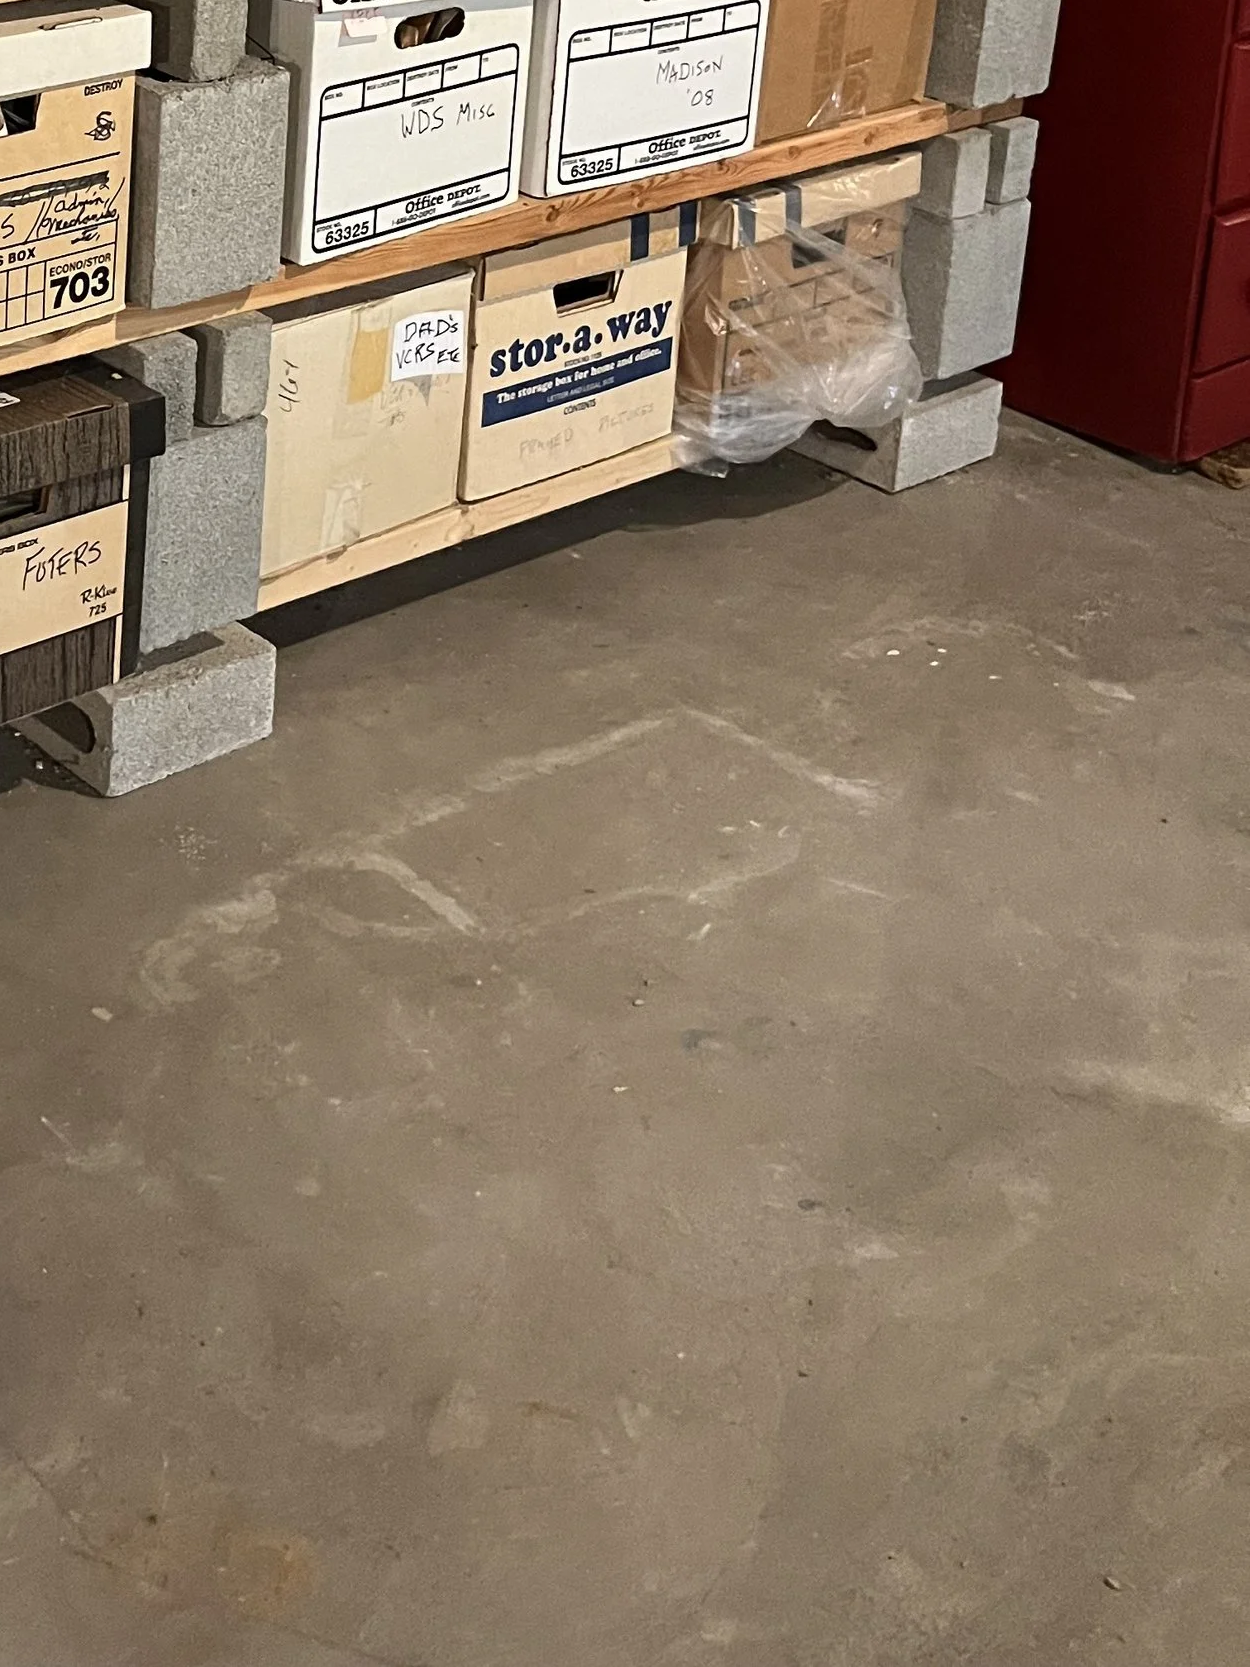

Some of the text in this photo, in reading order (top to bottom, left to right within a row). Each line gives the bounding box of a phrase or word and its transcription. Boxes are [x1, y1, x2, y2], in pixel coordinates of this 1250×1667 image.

[655, 56, 723, 84] MADISON
[84, 79, 123, 96] DESTROY
[401, 106, 444, 138] WDS
[648, 130, 721, 154] Office DEPOT
[571, 158, 613, 177] 63325
[405, 184, 481, 214] Office DEPOT
[325, 221, 369, 245] 63325
[9, 248, 36, 263] BOX
[50, 253, 111, 277] ECONO/STOR
[50, 266, 110, 309] 703
[497, 348, 662, 403] The storage box for home and office.
[18, 538, 39, 550] BOX
[22, 541, 100, 590] FUTERS
[89, 605, 106, 617] 725
